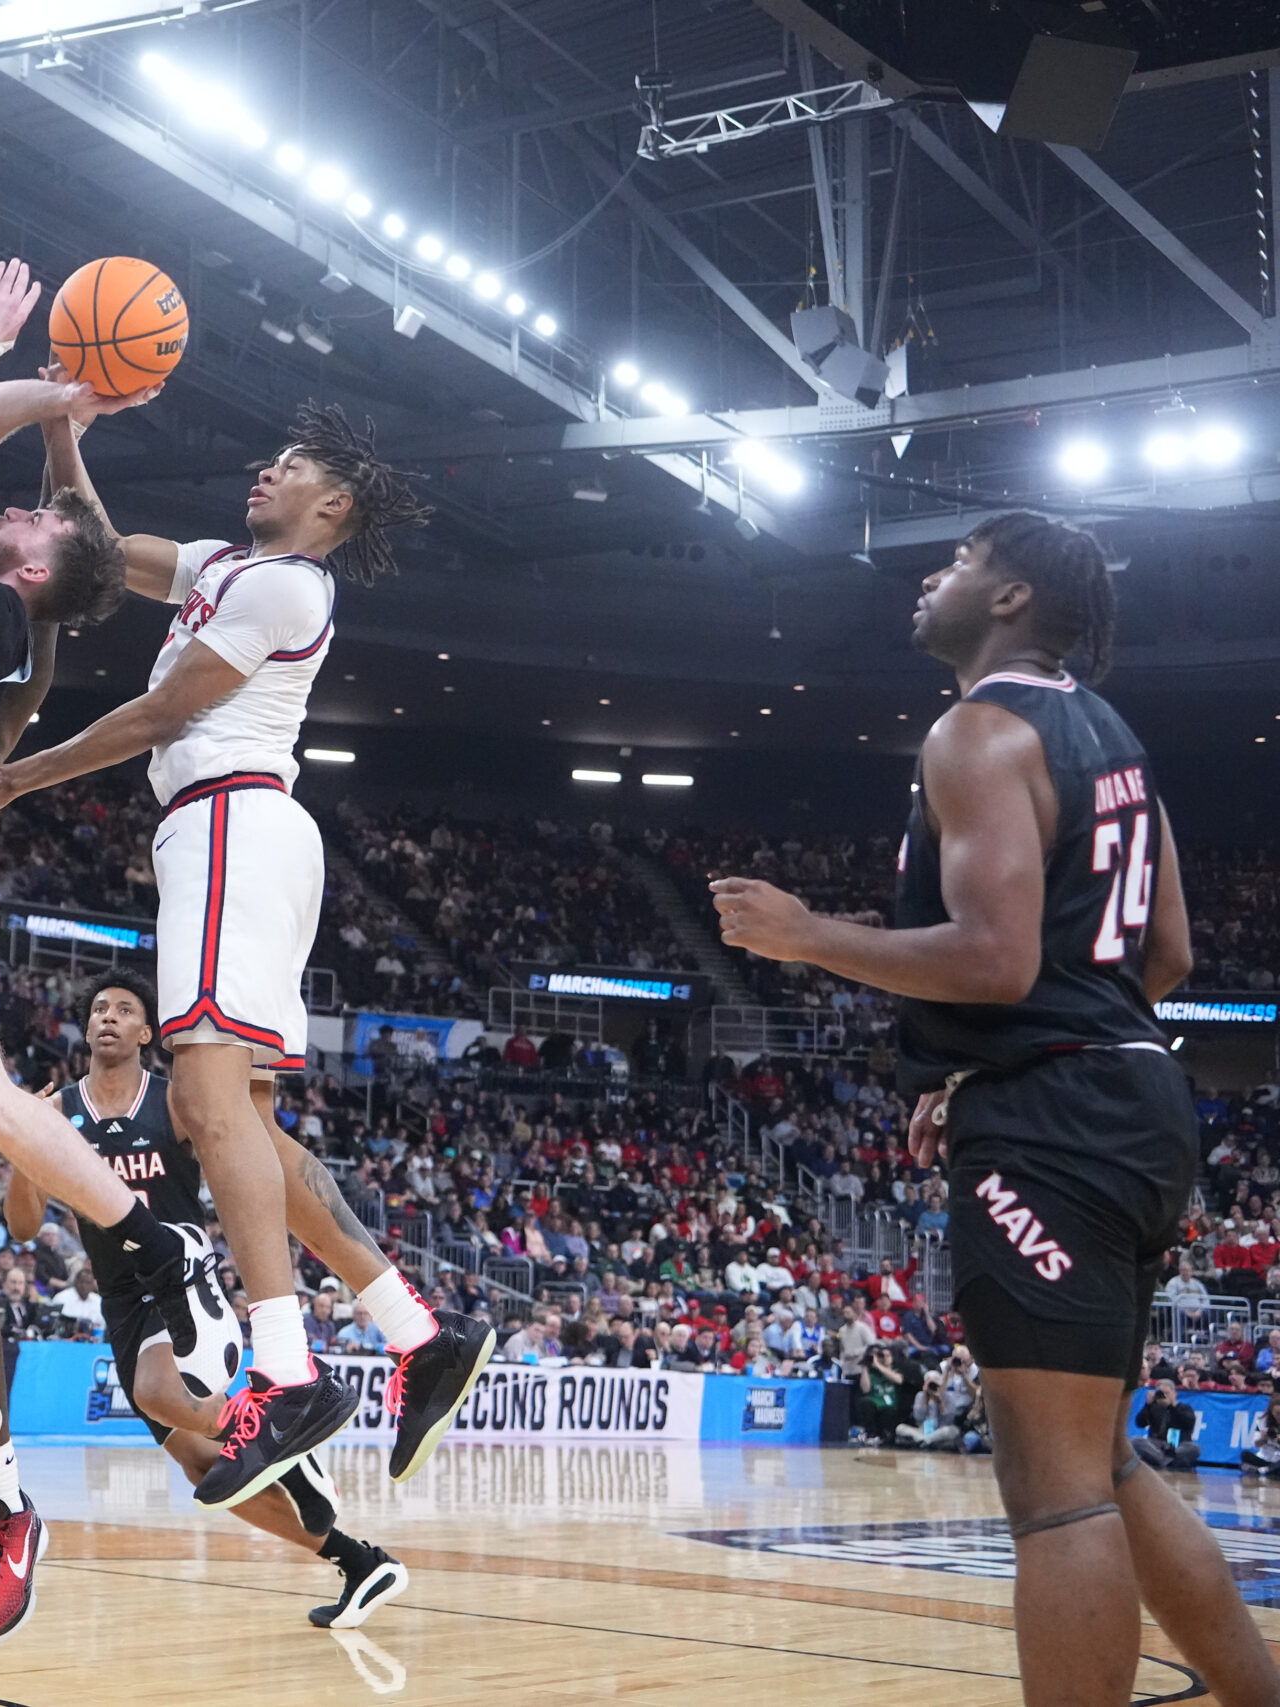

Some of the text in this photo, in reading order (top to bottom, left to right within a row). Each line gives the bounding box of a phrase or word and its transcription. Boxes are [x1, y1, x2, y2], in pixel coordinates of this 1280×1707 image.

[1092, 811, 1153, 963] 24
[975, 1171, 1073, 1282] MAVS
[558, 1375, 669, 1431] ROUNDS
